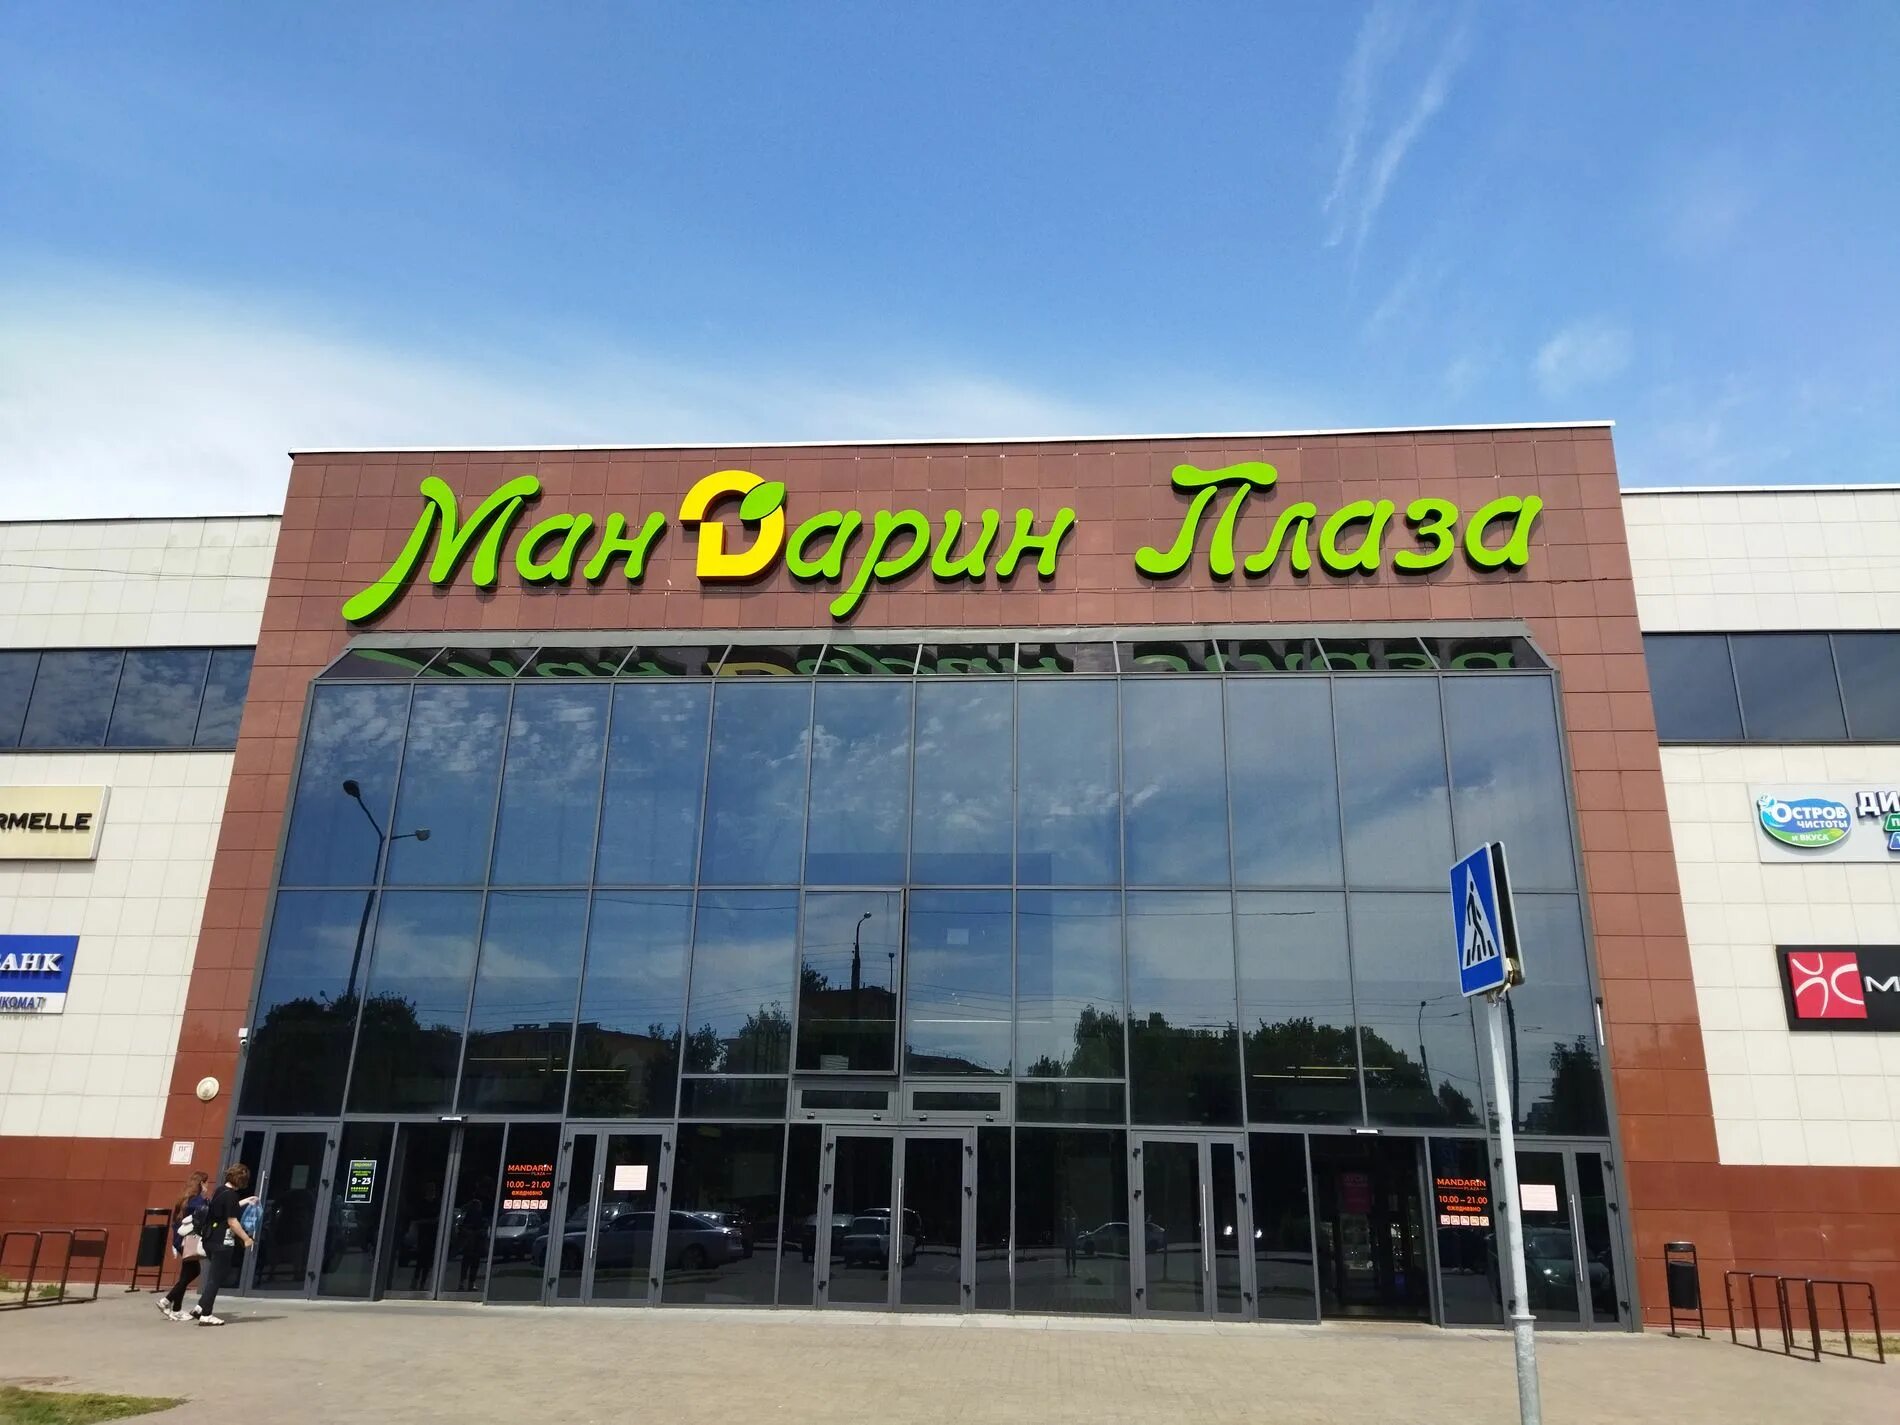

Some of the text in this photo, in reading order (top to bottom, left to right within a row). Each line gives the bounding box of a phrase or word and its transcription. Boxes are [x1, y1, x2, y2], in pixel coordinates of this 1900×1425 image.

[1135, 461, 1544, 577] Плаза
[1796, 819, 1848, 829] ЧИСТОТЫ
[1799, 833, 1830, 841] ВКУСА
[0, 953, 62, 971] АНК
[0, 996, 45, 1010] КОМАТ
[507, 1164, 553, 1172] MANDARIN
[351, 1177, 358, 1185] 9
[361, 1177, 372, 1185] 23
[506, 1180, 525, 1189] 10.00
[531, 1180, 551, 1189] 21.00
[1437, 1178, 1487, 1187] MANDARIN
[1439, 1195, 1460, 1204] 10.00
[1466, 1196, 1488, 1205] 21.00
